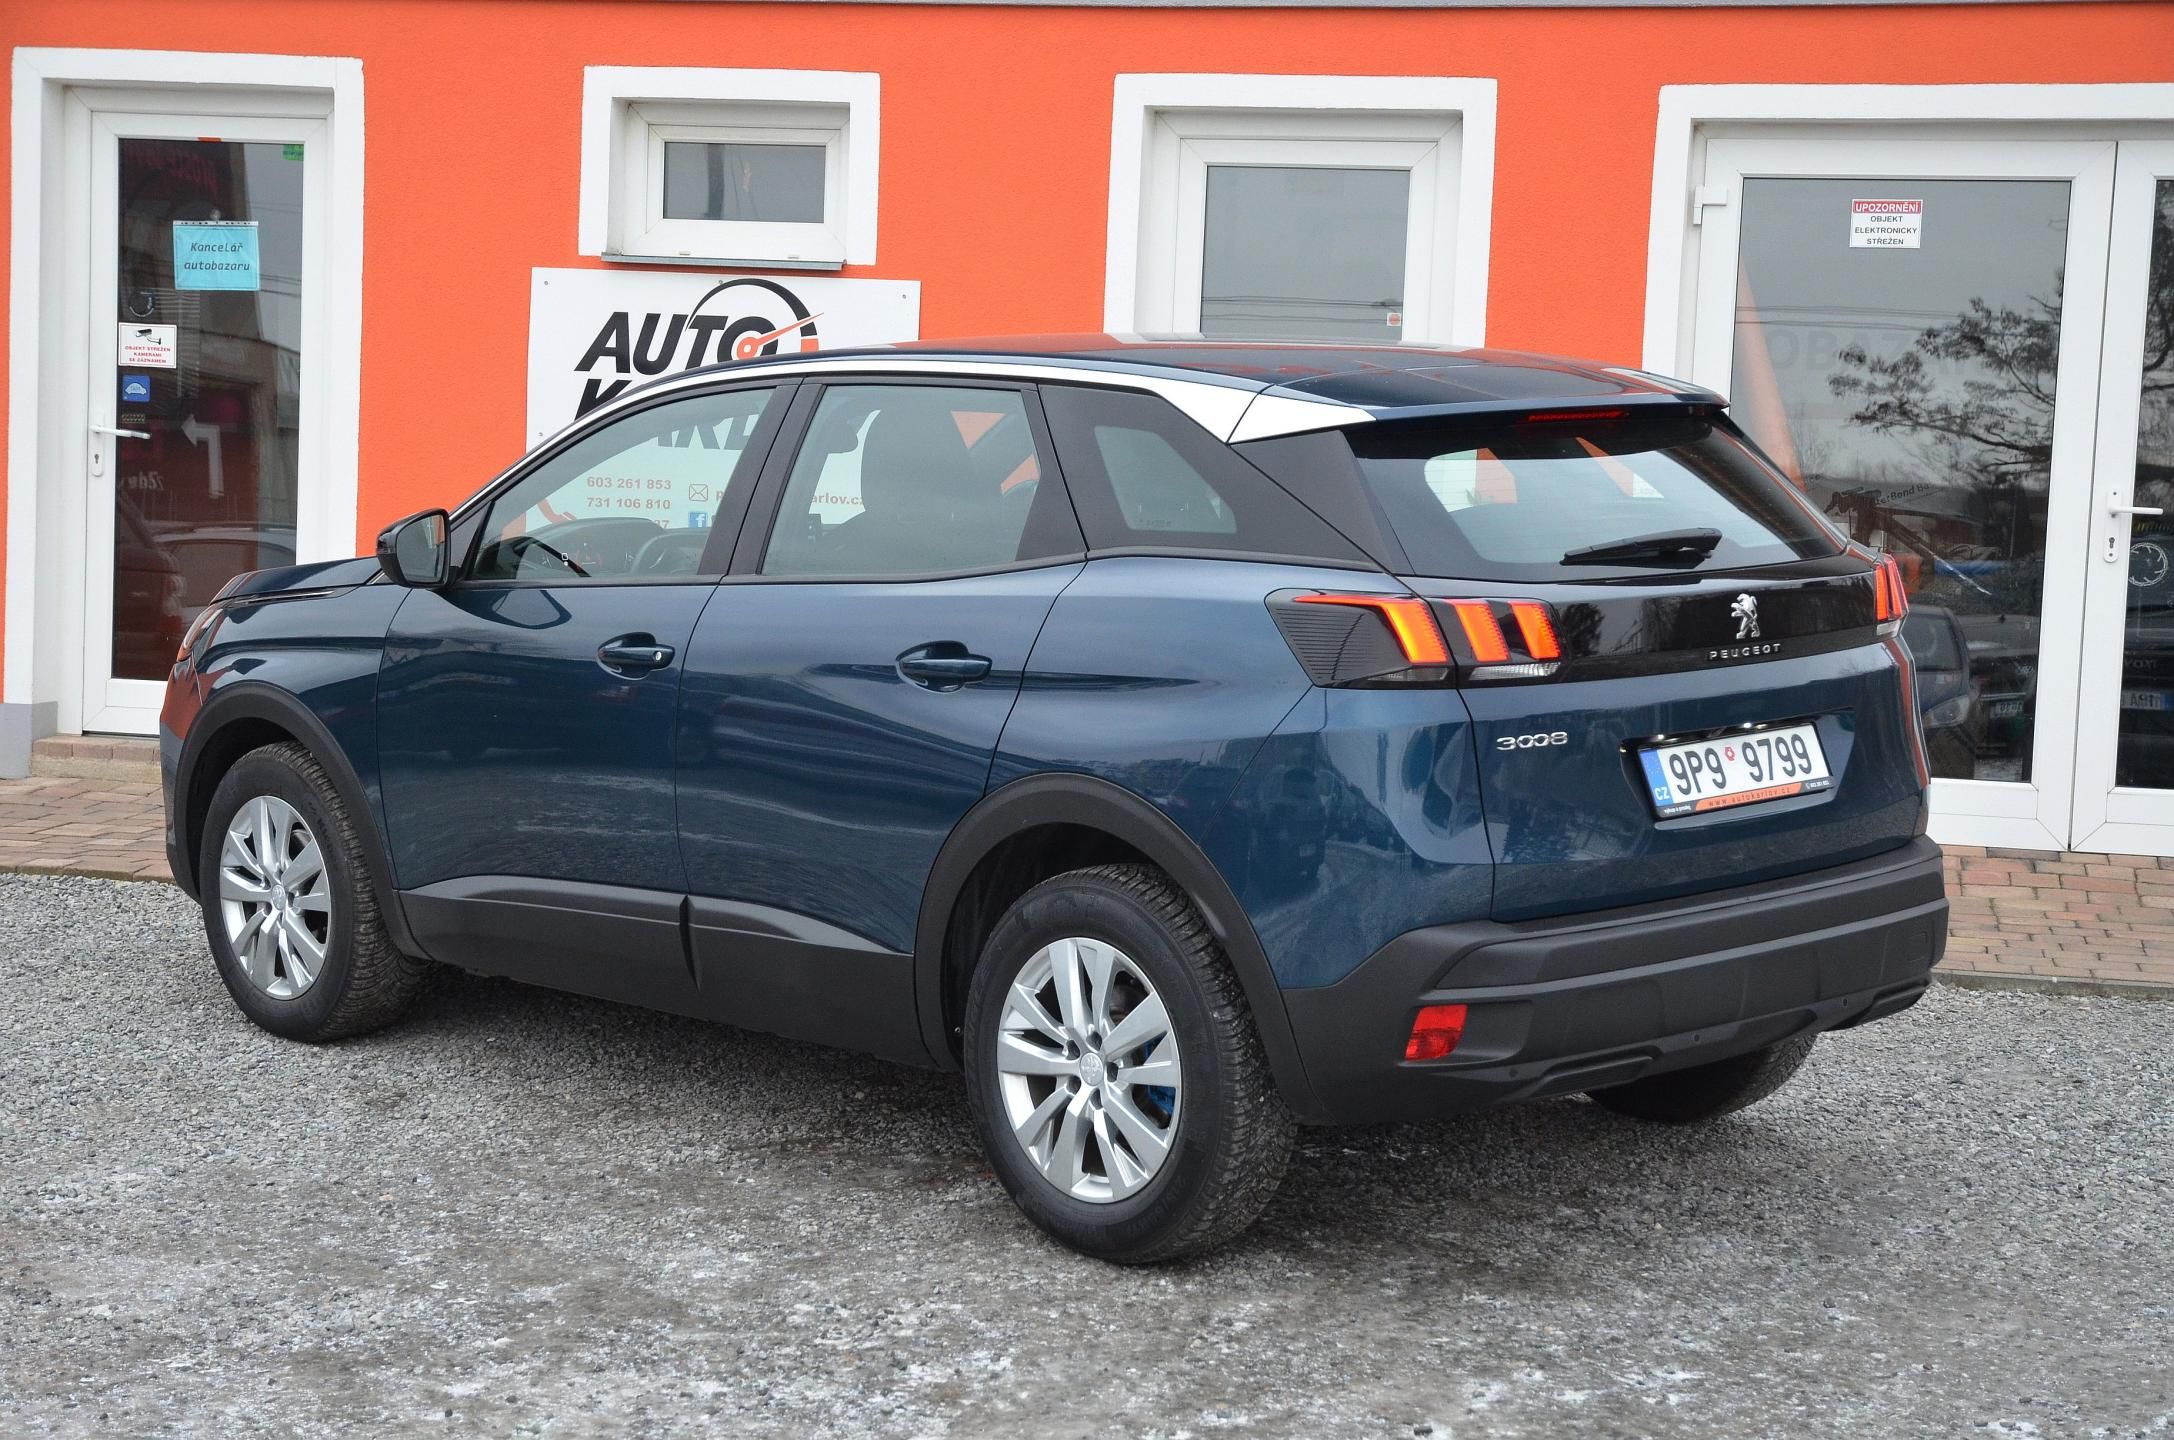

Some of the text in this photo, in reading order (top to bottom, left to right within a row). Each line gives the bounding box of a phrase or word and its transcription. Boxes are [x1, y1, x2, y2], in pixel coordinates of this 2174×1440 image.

[1855, 201, 1919, 212] UPOZORNĚNÍ
[1870, 215, 1903, 223] OBJEKT
[1855, 226, 1917, 234] ELEKTRONICKY
[190, 242, 244, 253] Kancelář
[1866, 237, 1904, 245] STŘEŽEN
[184, 261, 250, 271] autobazaru
[574, 311, 779, 376] AUTO
[586, 476, 672, 490] 603 261 853
[586, 497, 671, 510] 731 106 810
[1709, 643, 1782, 660] PEUGEOT
[1496, 731, 1569, 751] 3008
[1669, 733, 1812, 796] 9P9 9799
[1654, 786, 1670, 800] CZ
